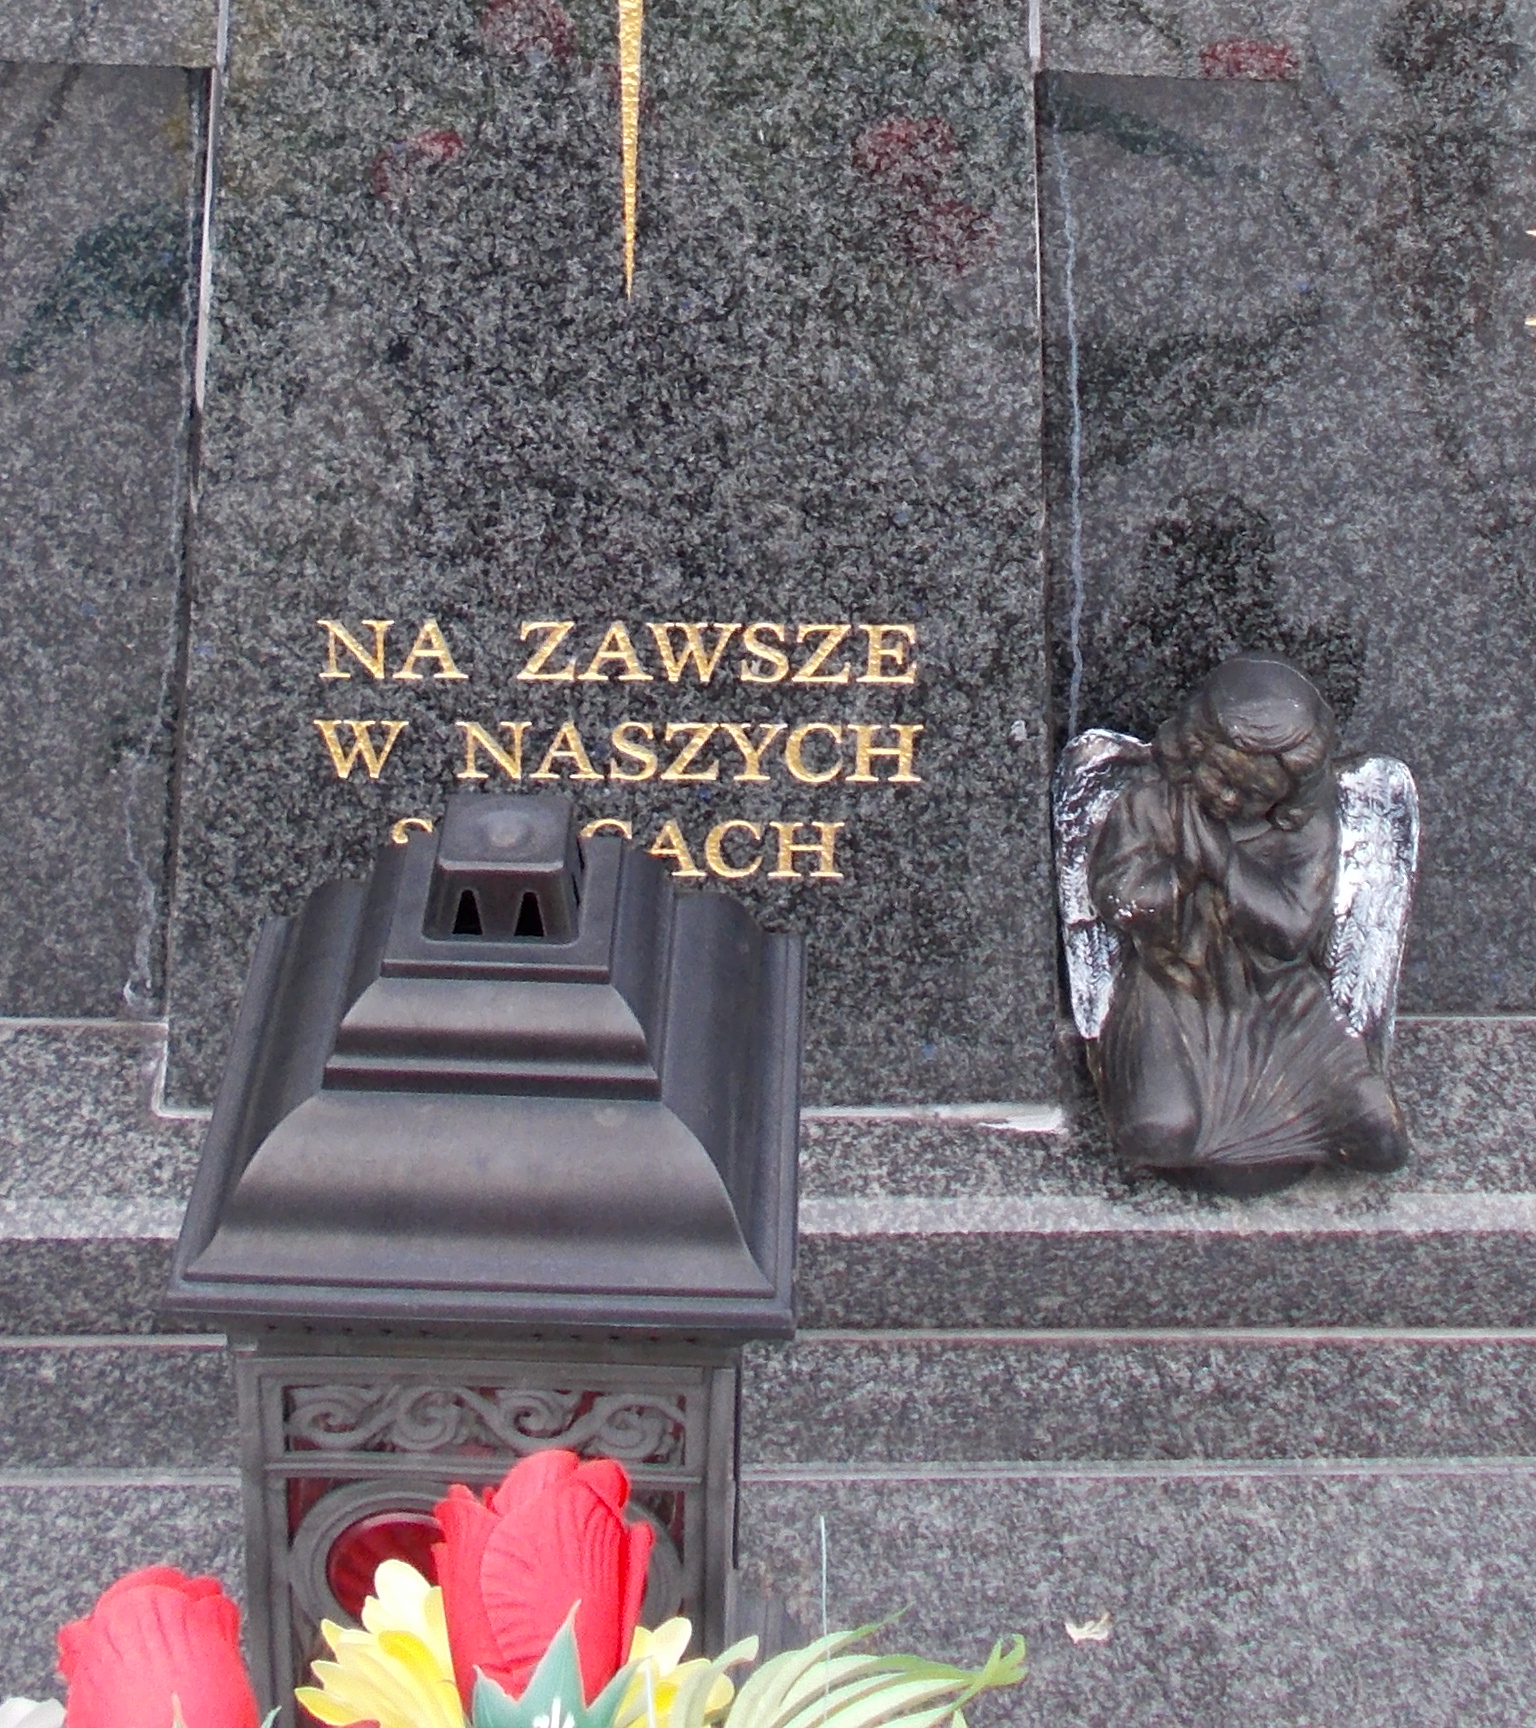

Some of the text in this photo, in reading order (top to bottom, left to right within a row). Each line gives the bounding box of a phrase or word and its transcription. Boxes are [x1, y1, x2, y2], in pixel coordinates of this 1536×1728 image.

[315, 619, 919, 684] NA ZAWSZE
[313, 719, 923, 783] W NASZYCH
